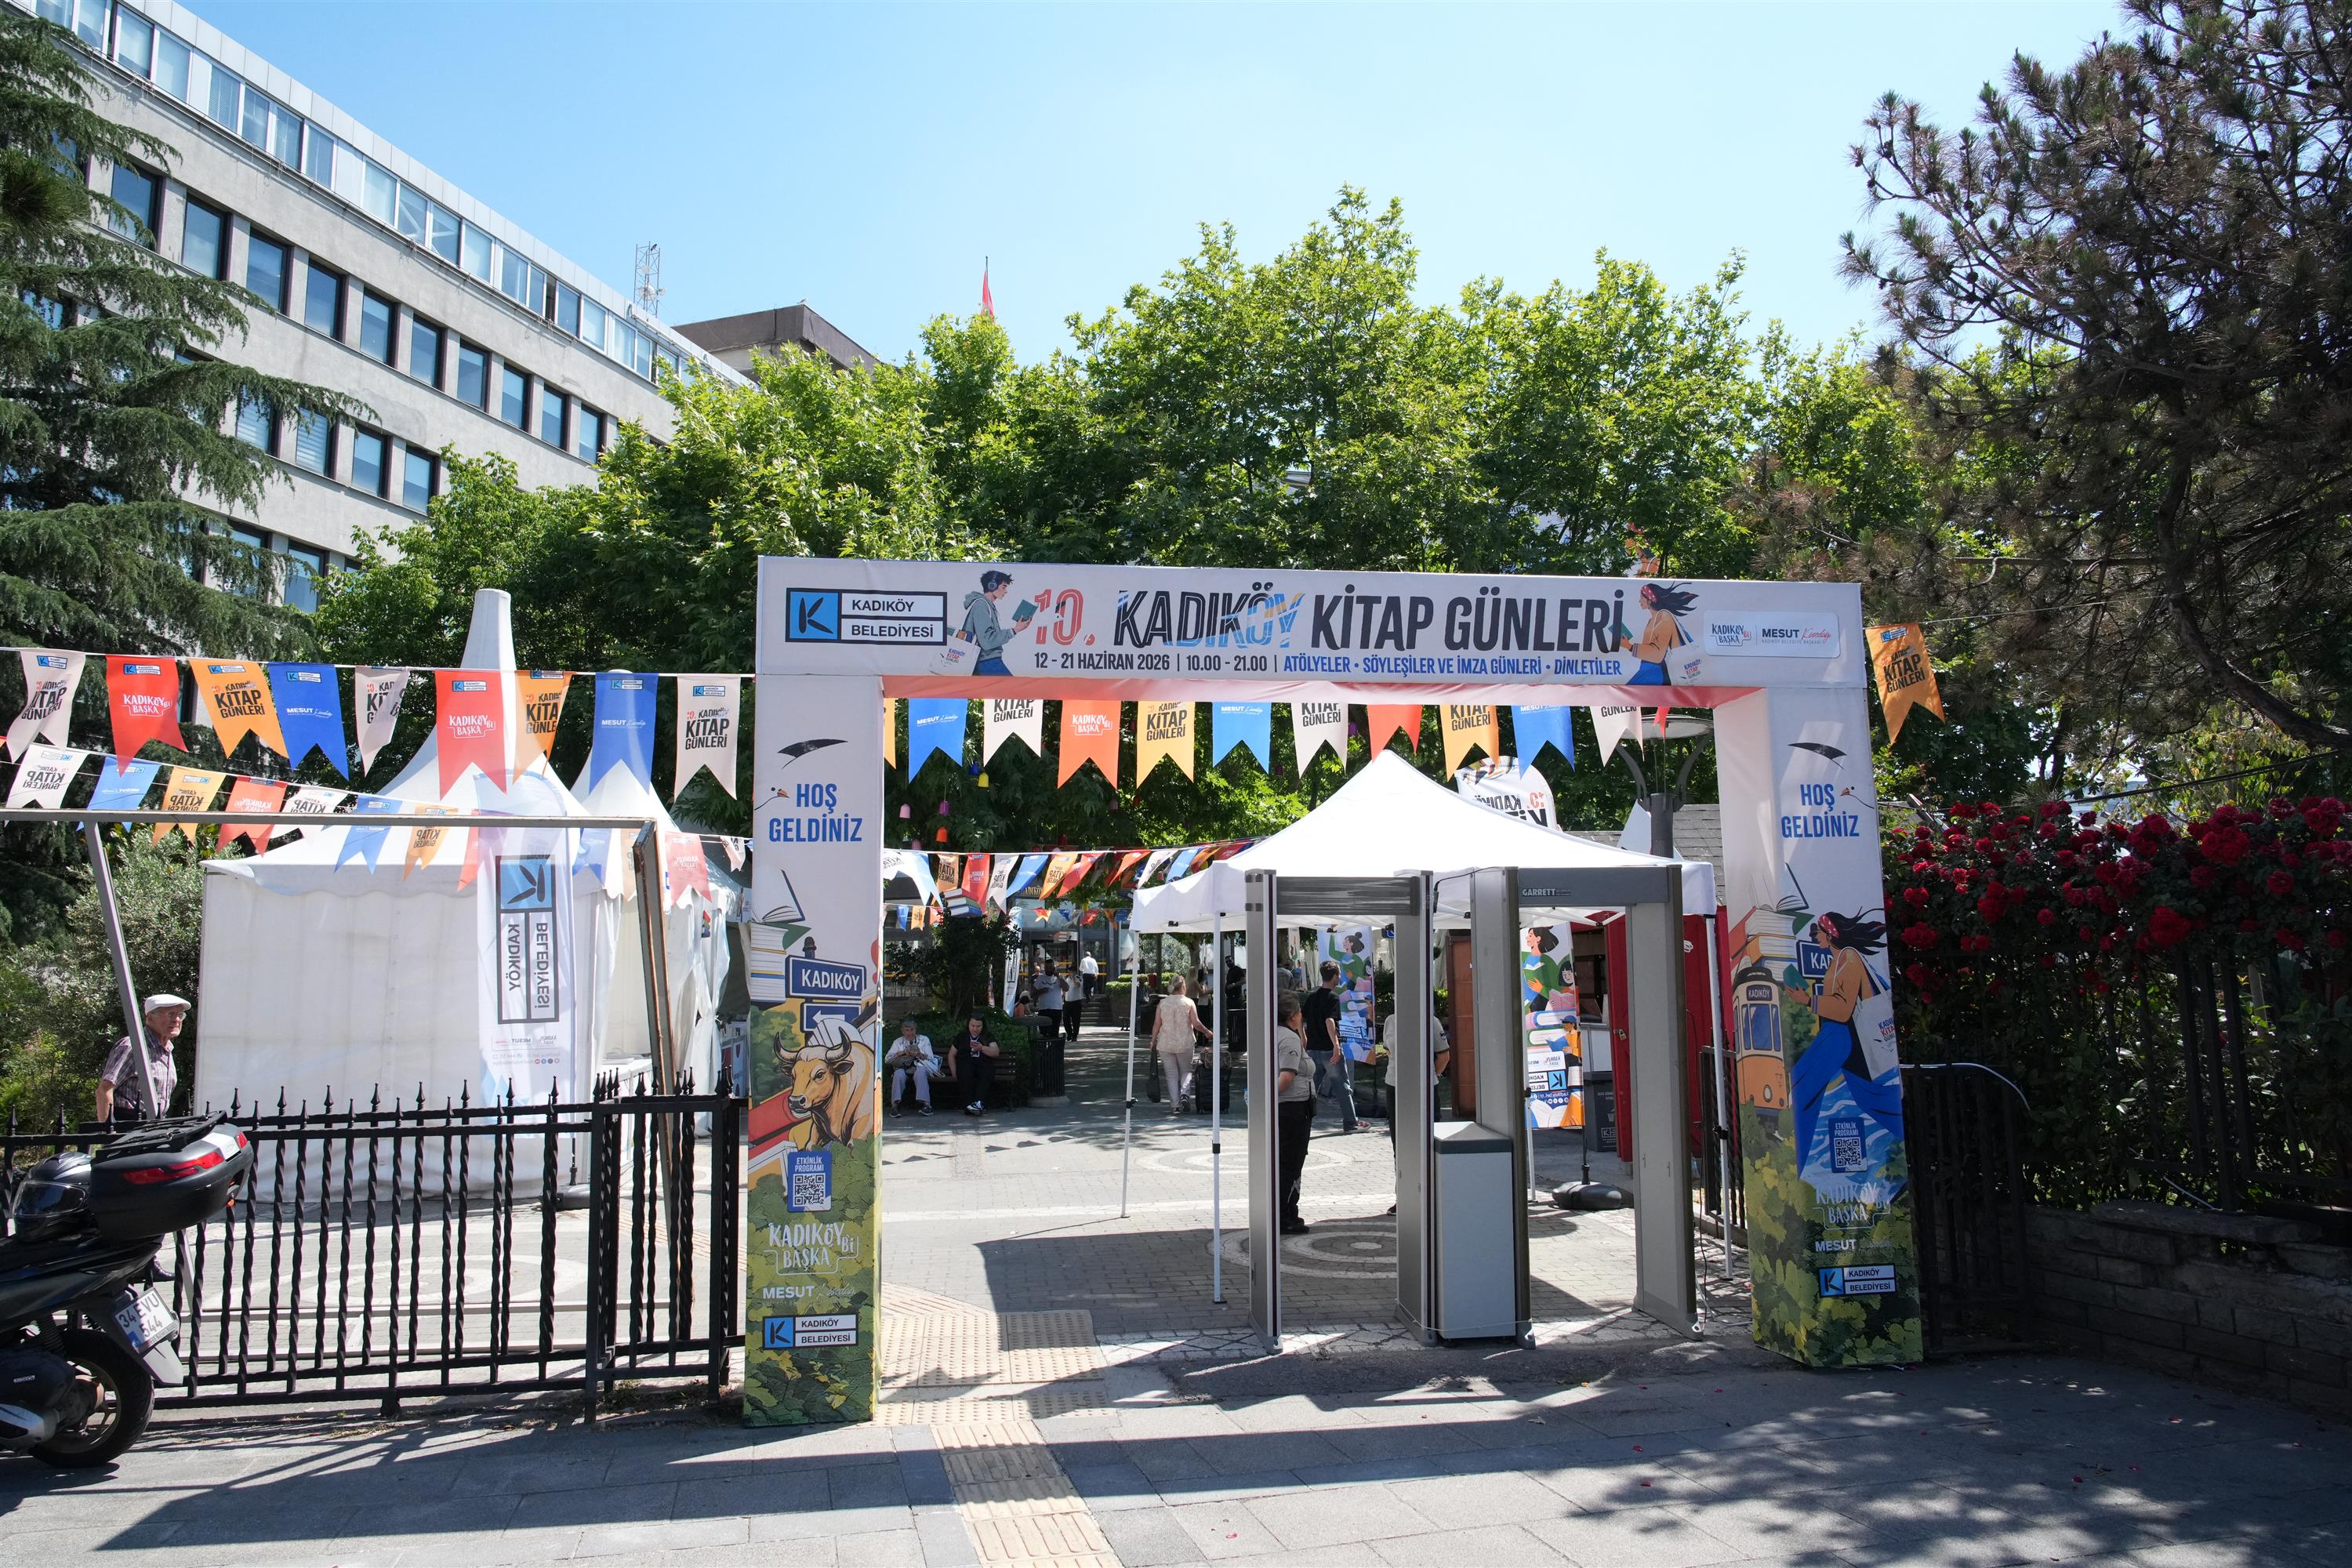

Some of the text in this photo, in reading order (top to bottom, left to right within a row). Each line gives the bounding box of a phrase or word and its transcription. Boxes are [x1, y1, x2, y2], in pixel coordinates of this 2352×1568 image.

[851, 598, 915, 613] KADIKÖY
[1034, 582, 1624, 654] 10. KADIKÖY KİTAP GÜNLERİ
[851, 622, 934, 637] BELEDİYESİ
[1711, 623, 1744, 635] KADIKÖY
[1762, 628, 1800, 638] MESUT
[1719, 635, 1740, 645] BAŞKA
[1034, 652, 1048, 669] 12
[1061, 652, 1074, 670] 21
[1077, 651, 1135, 670] HAZİRAN
[1137, 654, 1170, 670] 2026
[1186, 655, 1221, 671] 10.00
[1233, 655, 1268, 672] 21.00
[1283, 652, 1351, 673] ATÖLYELER
[1363, 653, 1436, 677] SÖYLEŞİLER
[1437, 656, 1454, 674] VE
[1457, 655, 1488, 675] İMZA
[1490, 655, 1542, 676] GÜNLERİ
[1554, 655, 1622, 676] DİNLETİLER
[1883, 654, 1921, 682] KİTAP
[1886, 667, 1926, 694] GÜNLERİ
[123, 693, 165, 707] KADIKÖY
[215, 689, 262, 709] KİTAP
[132, 706, 159, 715] BAŞKA
[220, 703, 266, 719] GÜNLERİ
[526, 702, 559, 722] KİTA
[993, 706, 1033, 723] GÜNLERİ
[1302, 709, 1341, 727] GÜNLERİ
[449, 714, 488, 726] KADIKÖY
[526, 720, 557, 734] GÜNLE
[685, 717, 730, 738] KİTAP
[916, 716, 940, 724] MESUT
[1073, 714, 1106, 725] KADIKÖY
[1146, 710, 1188, 730] KİTAP
[1451, 711, 1490, 731] GÜNLERİ
[457, 726, 482, 737] BAŞKA
[1078, 724, 1099, 734] BAŞKA
[1146, 724, 1186, 741] GÜNLERİ
[685, 734, 728, 750] GÜNLERİ
[796, 783, 837, 814] HOŞ
[1800, 783, 1835, 812] HOŞ
[769, 813, 862, 843] GELDİNİZ
[1780, 811, 1860, 839] GELDİNİZ
[801, 967, 860, 992] KADIKÖY
[1748, 988, 1770, 998] KADIKÖY
[796, 1156, 822, 1165] ETKİNLİK
[1816, 1181, 1878, 1205] KADIKÖY
[1828, 1204, 1868, 1226] BAŞKA
[768, 1222, 845, 1248] KADIKÖY
[1815, 1239, 1857, 1252] MESUT
[783, 1247, 832, 1272] BAŞKA
[1849, 1269, 1880, 1278] KADIKÖY
[763, 1285, 815, 1300] MESUT
[1849, 1282, 1891, 1292] BELEDİYESİ
[118, 1293, 159, 1328] 34 EVU
[140, 1315, 163, 1338] 544
[801, 1319, 839, 1328] KADIKÖY
[801, 1334, 851, 1345] BELEDİYESİ
